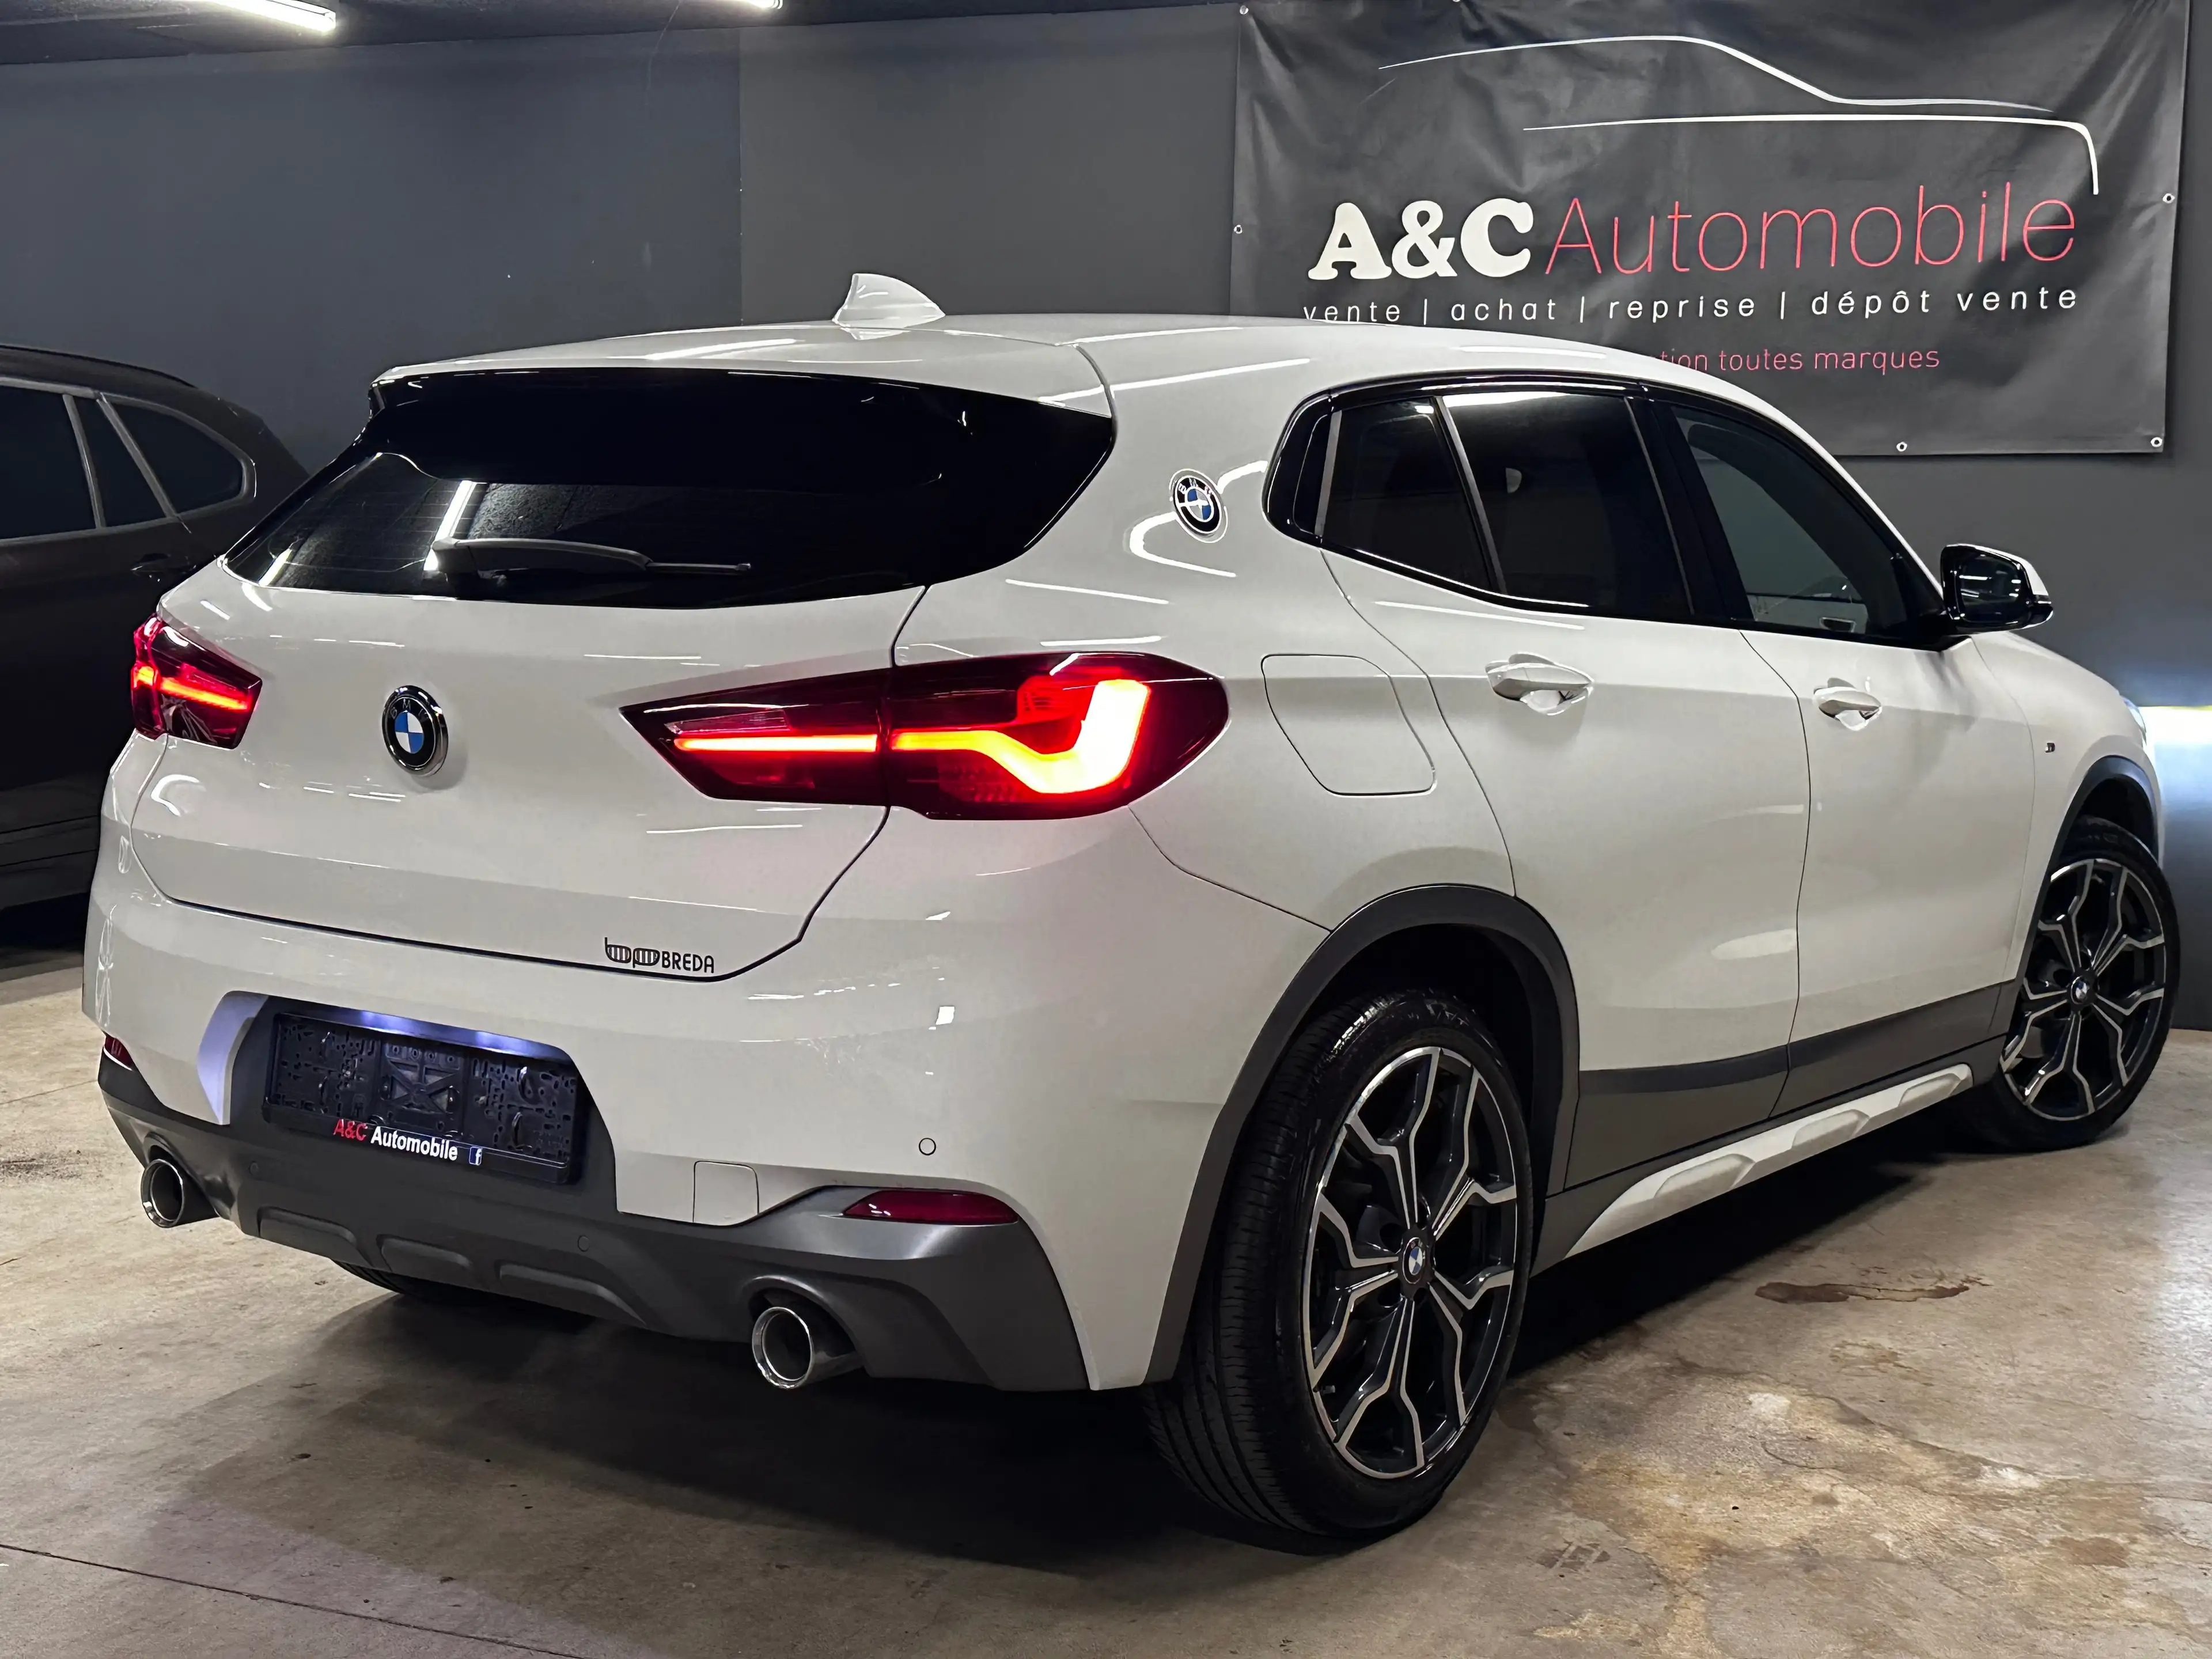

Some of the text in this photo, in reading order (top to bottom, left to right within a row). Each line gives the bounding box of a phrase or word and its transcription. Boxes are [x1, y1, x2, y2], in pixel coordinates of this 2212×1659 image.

[1308, 181, 2075, 281] A&C Automobile
[1303, 301, 1400, 323] vente
[1451, 298, 1556, 321] achat
[1609, 294, 1755, 323] reprise
[1812, 290, 1930, 319] dépôt
[1957, 287, 2077, 312] vente
[1719, 349, 1803, 372] toutes
[1813, 349, 1940, 376] marques
[662, 950, 714, 974] BREDA
[333, 1119, 368, 1141] A&C
[370, 1126, 459, 1161] Automobile
